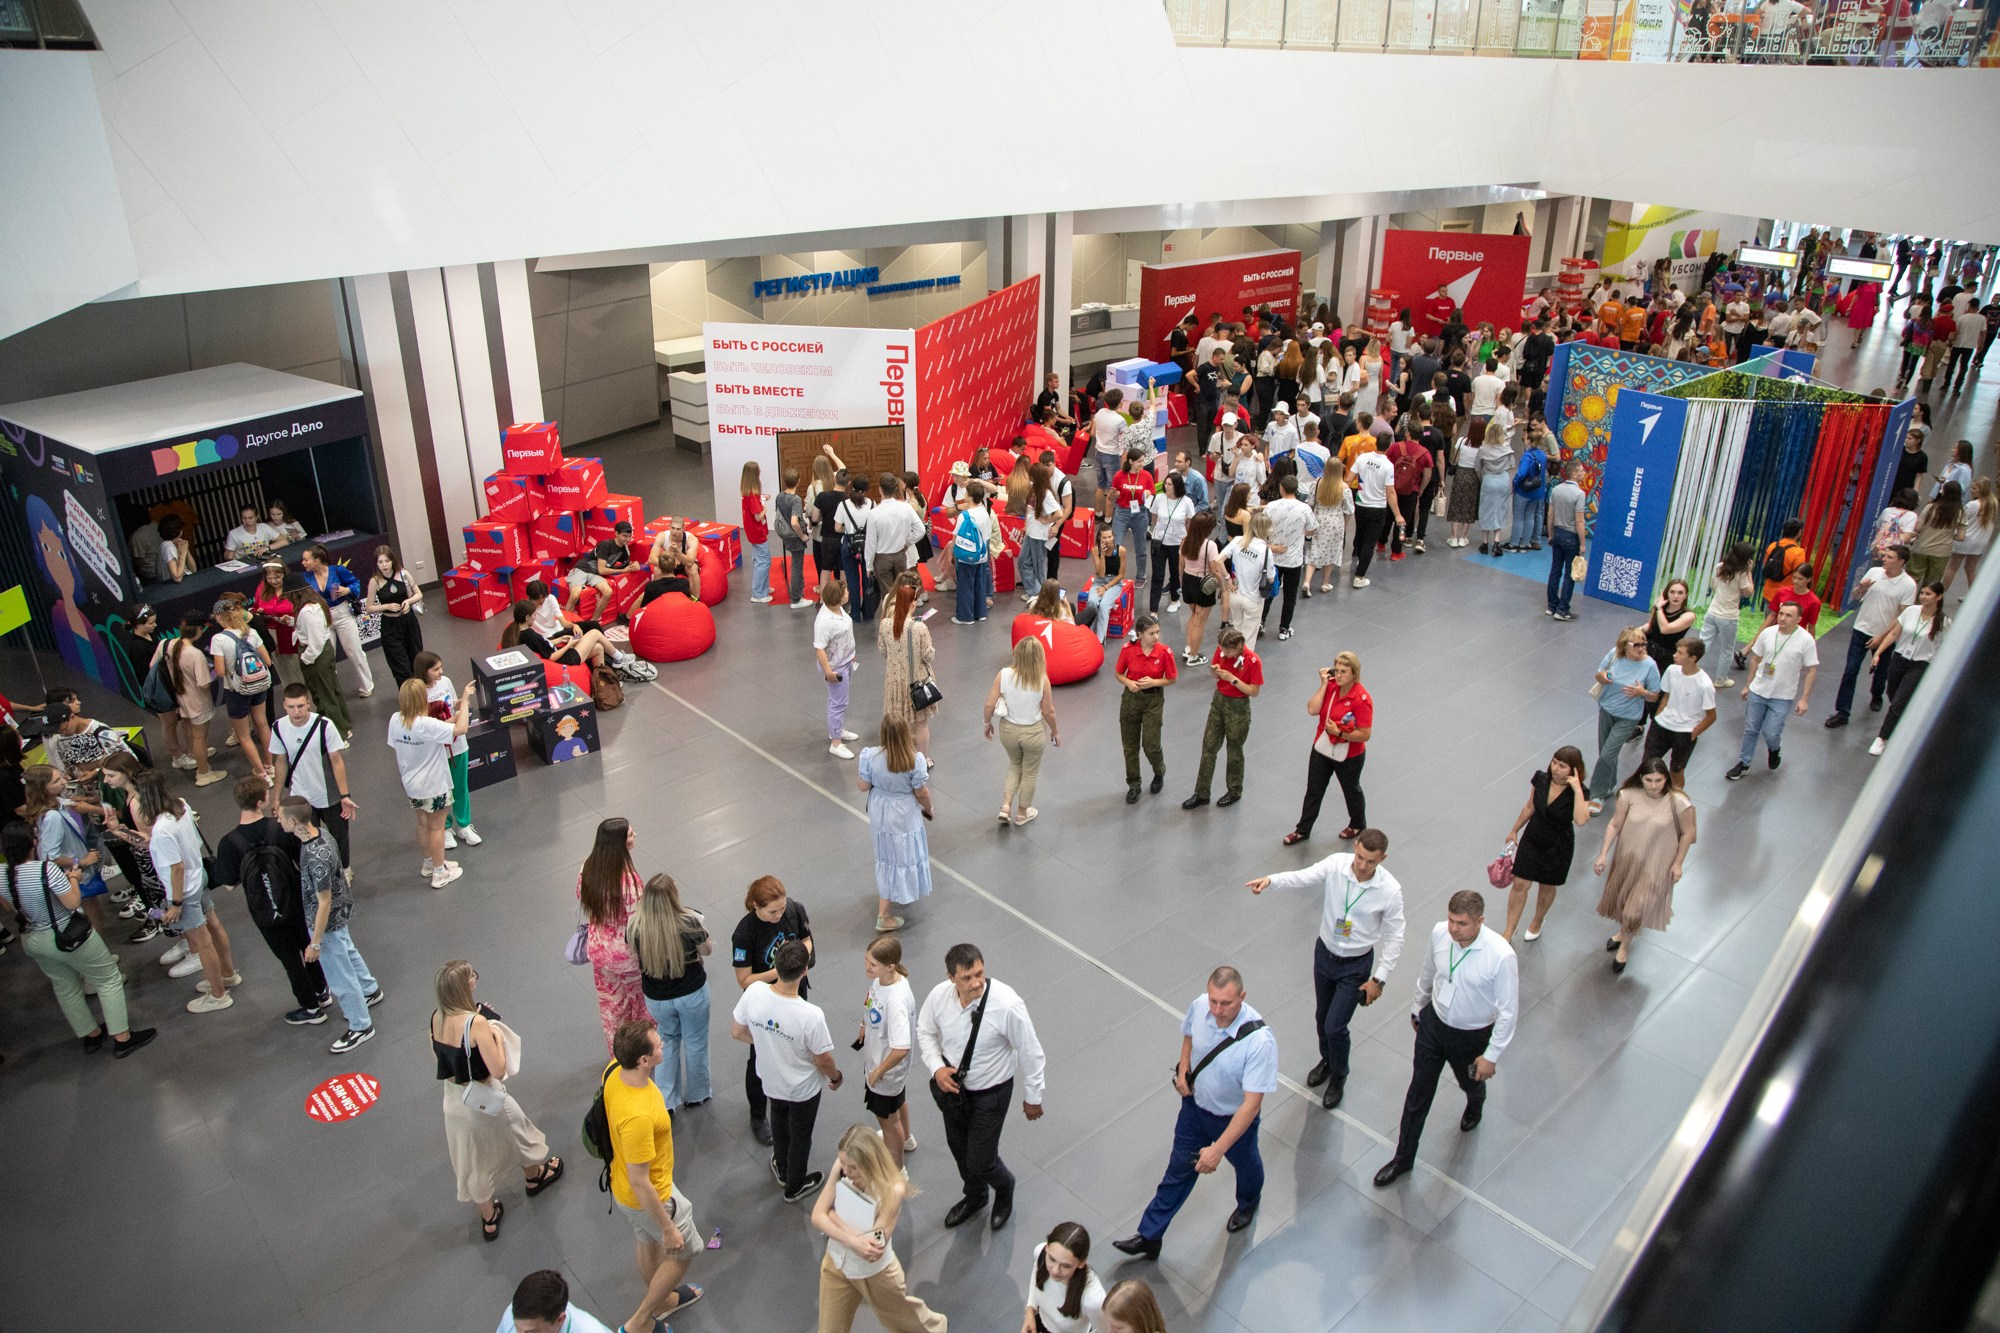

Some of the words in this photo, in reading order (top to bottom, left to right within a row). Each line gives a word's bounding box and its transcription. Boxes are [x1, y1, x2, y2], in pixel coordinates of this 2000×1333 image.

[1428, 246, 1485, 264] Первые
[753, 266, 880, 298] РЕГИСТРАЦИЯ
[1243, 273, 1261, 283] БЫТЬ
[1261, 272, 1266, 280] С
[1266, 266, 1294, 279] РОССИЕЙ
[1164, 293, 1197, 308] Первые
[1250, 303, 1264, 312] БЫТ
[713, 339, 748, 350] БЫТЬ
[750, 341, 759, 351] С
[762, 341, 824, 353] РОССИЕЙ
[714, 361, 750, 372] БЫТЬ
[751, 362, 833, 377] ЧЕЛОВЕКОМ
[715, 383, 750, 395] БЫТЬ
[753, 385, 805, 398] ВМЕСТЕ
[716, 404, 752, 416] БЫТЬ
[754, 405, 763, 416] В
[764, 406, 839, 420] ДВИЖЕНИИ
[1640, 401, 1664, 411] Первые
[245, 429, 289, 448] Другое
[291, 421, 324, 437] Дело
[718, 424, 753, 435] БЫТЬ
[507, 449, 544, 460] Первые
[547, 484, 580, 495] Первые
[1123, 483, 1144, 491] Первые
[1629, 467, 1645, 509] ВМЕСТЕ
[67, 496, 104, 542] СДЕЛАЛ
[68, 510, 96, 545] ДРУГОЕ
[1624, 504, 1638, 538] БЫТЬ
[69, 521, 103, 564] ТЕПЕРЬ
[535, 529, 550, 539] БЫТЬ
[549, 535, 569, 546] ВМЕСТЕ
[513, 528, 522, 565] Первые
[71, 535, 92, 564] ГУЛЯЙ
[93, 561, 119, 593] СМЕЛО
